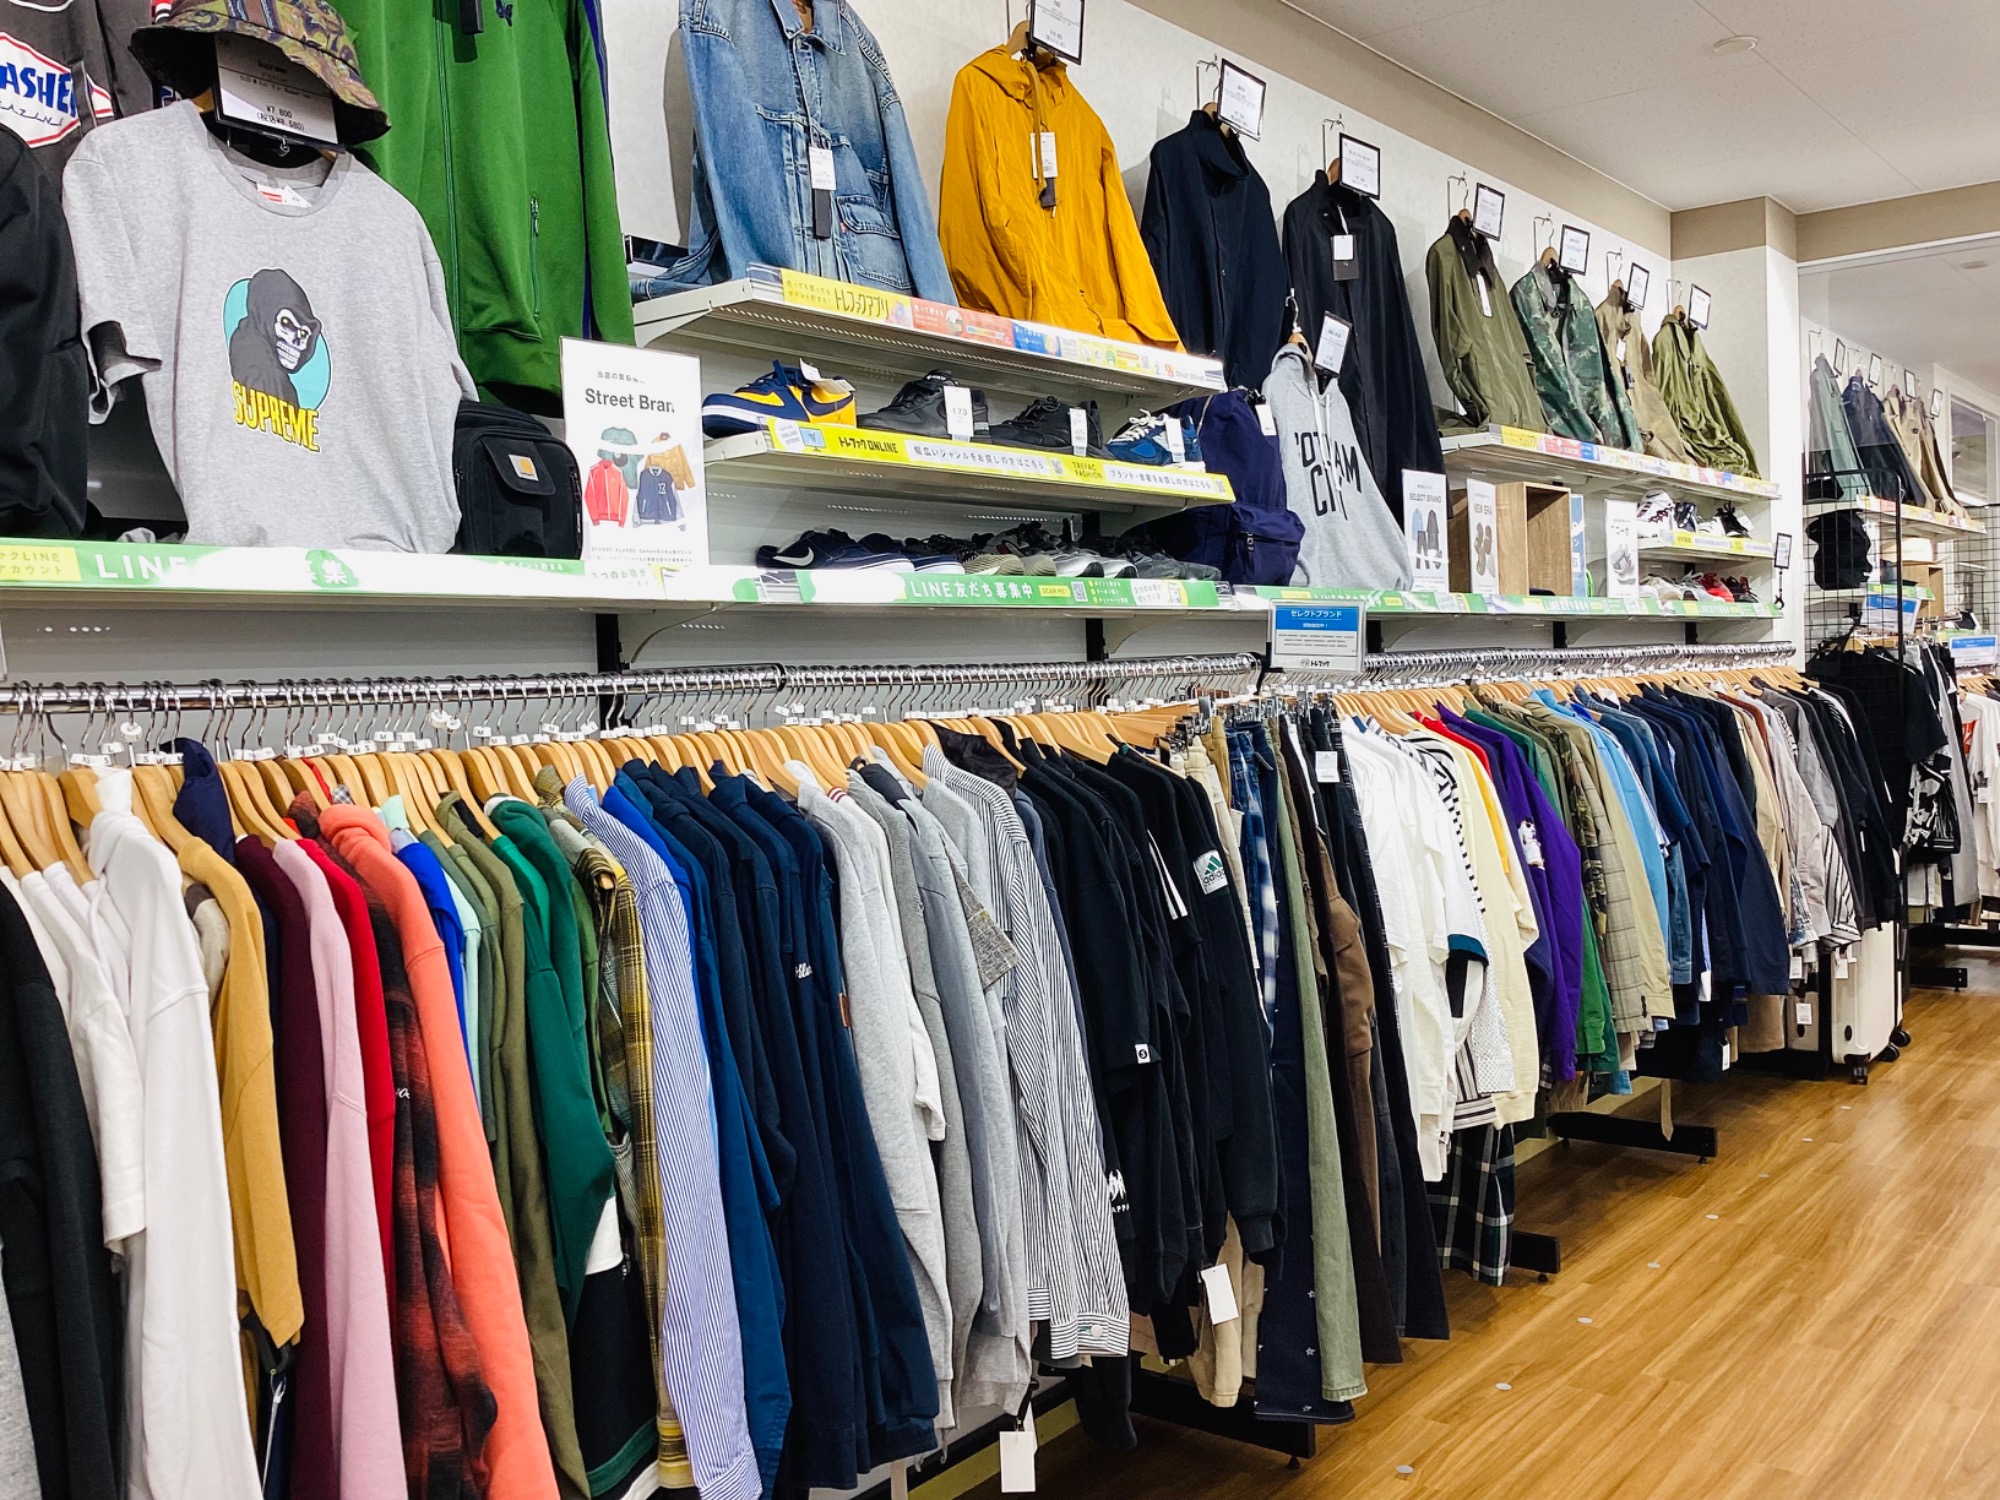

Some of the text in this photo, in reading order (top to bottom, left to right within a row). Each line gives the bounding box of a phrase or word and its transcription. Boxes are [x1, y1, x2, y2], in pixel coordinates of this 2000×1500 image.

[585, 387, 635, 409] Street
[231, 379, 321, 452] SUPREME
[910, 581, 1033, 599] LINE友だち募集中
[1291, 610, 1342, 619] セレクトブランド
